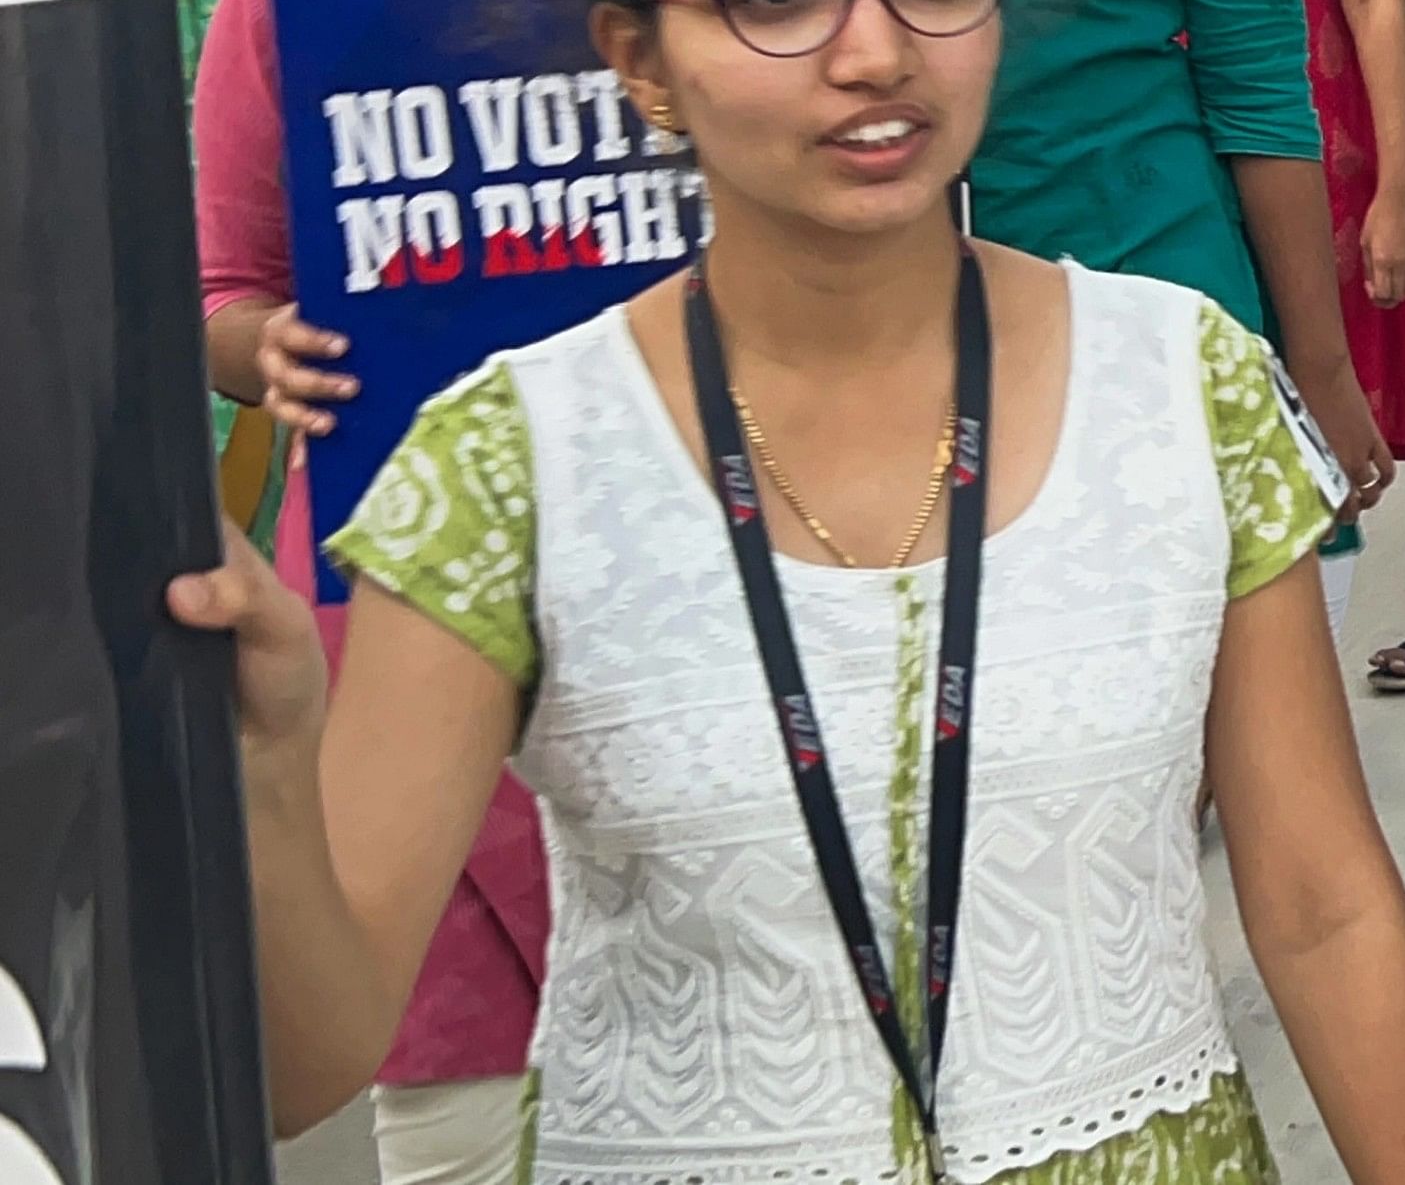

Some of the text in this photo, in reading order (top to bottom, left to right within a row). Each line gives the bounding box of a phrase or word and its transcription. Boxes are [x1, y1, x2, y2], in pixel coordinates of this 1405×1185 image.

[323, 85, 450, 188] NO
[336, 166, 716, 293] NO RIGHT
[952, 416, 982, 487] VEDA
[936, 666, 966, 741] VEDA
